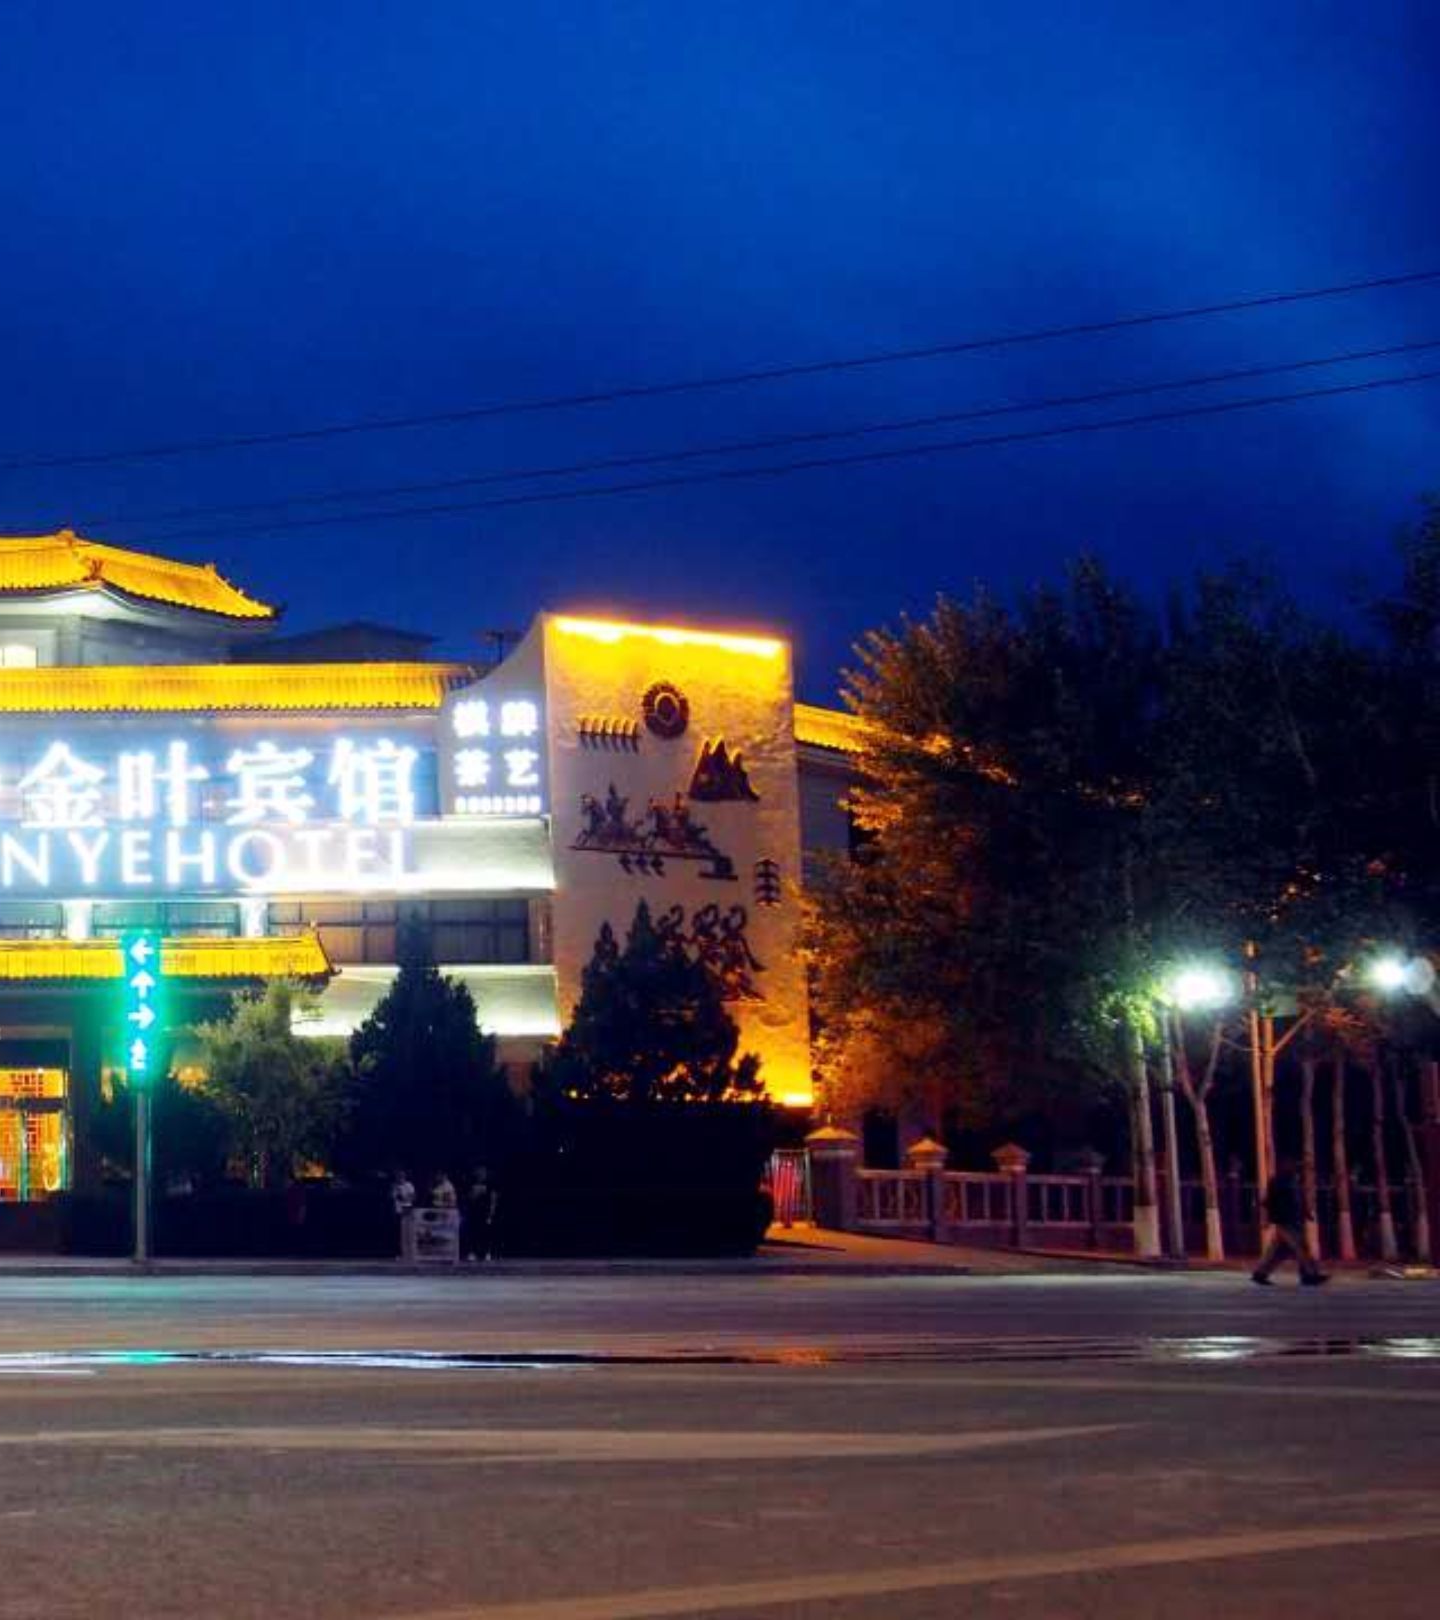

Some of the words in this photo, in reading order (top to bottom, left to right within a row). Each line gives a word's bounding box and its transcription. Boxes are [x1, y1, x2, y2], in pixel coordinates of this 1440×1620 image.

[18, 740, 419, 829] 金叶宾馆
[454, 749, 538, 787] 茶艺
